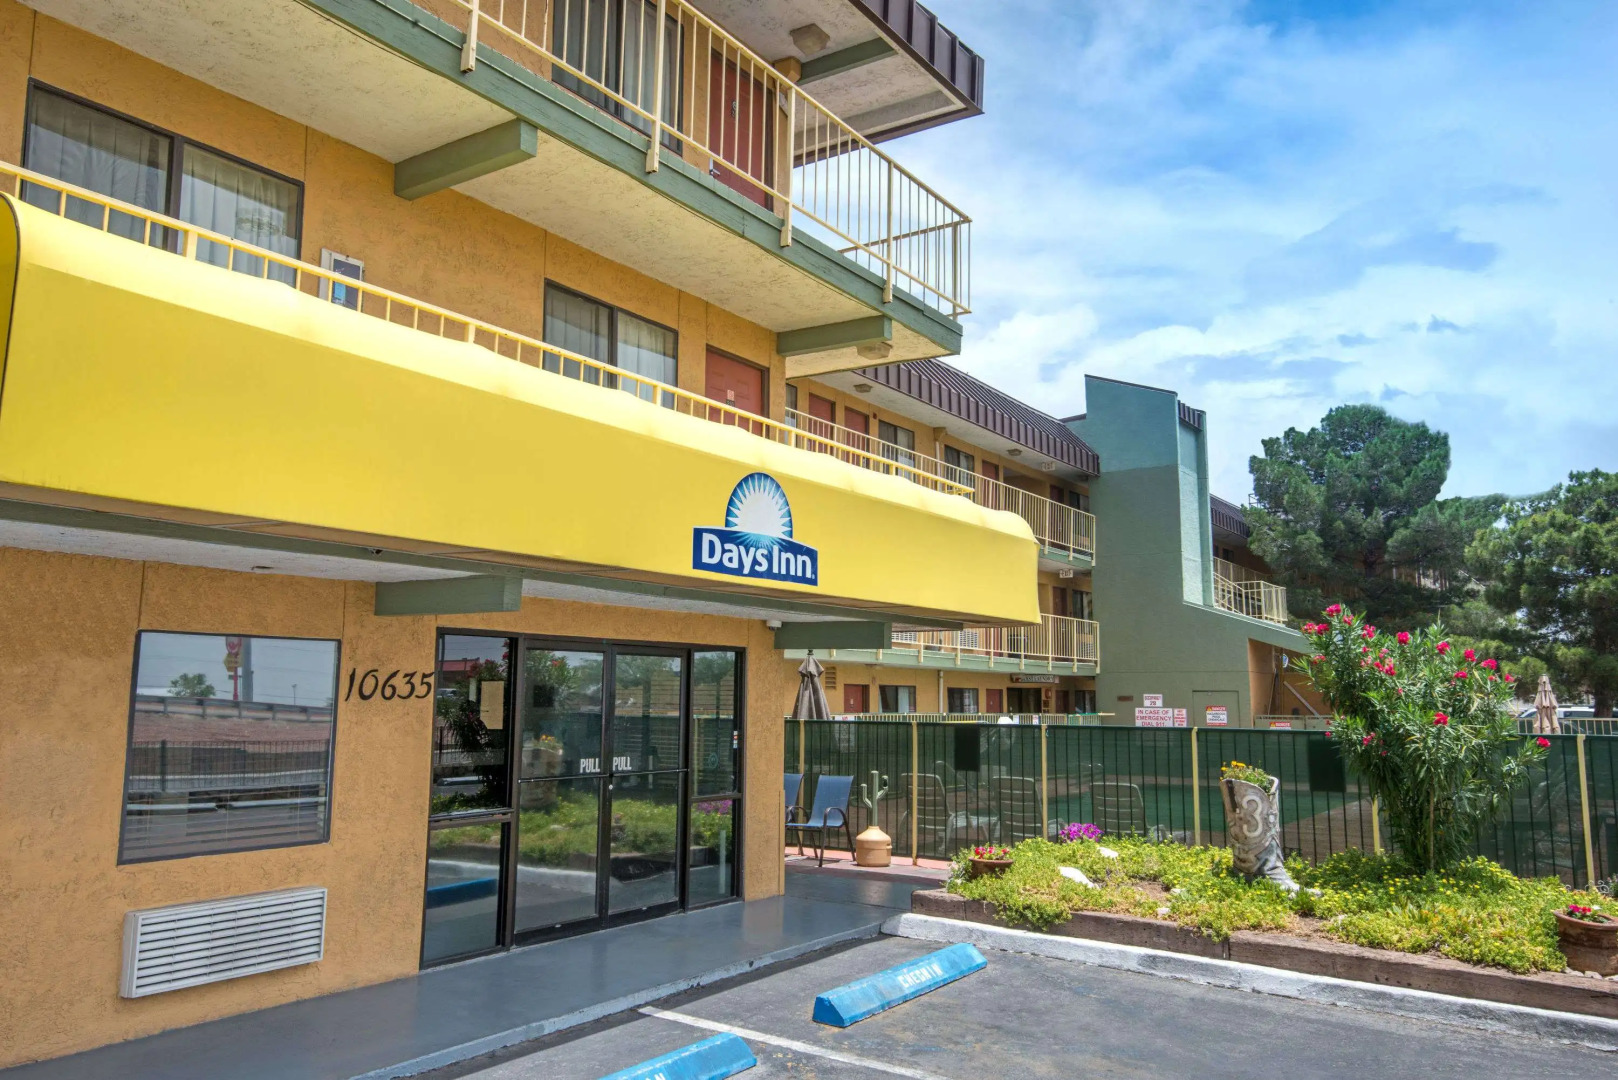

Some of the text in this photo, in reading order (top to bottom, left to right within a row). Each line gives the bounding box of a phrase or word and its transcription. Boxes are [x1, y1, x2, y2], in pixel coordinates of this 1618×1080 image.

[701, 532, 812, 579] Days Inn
[344, 667, 435, 702] 10635
[580, 758, 600, 773] PULL
[612, 756, 632, 771] PULL
